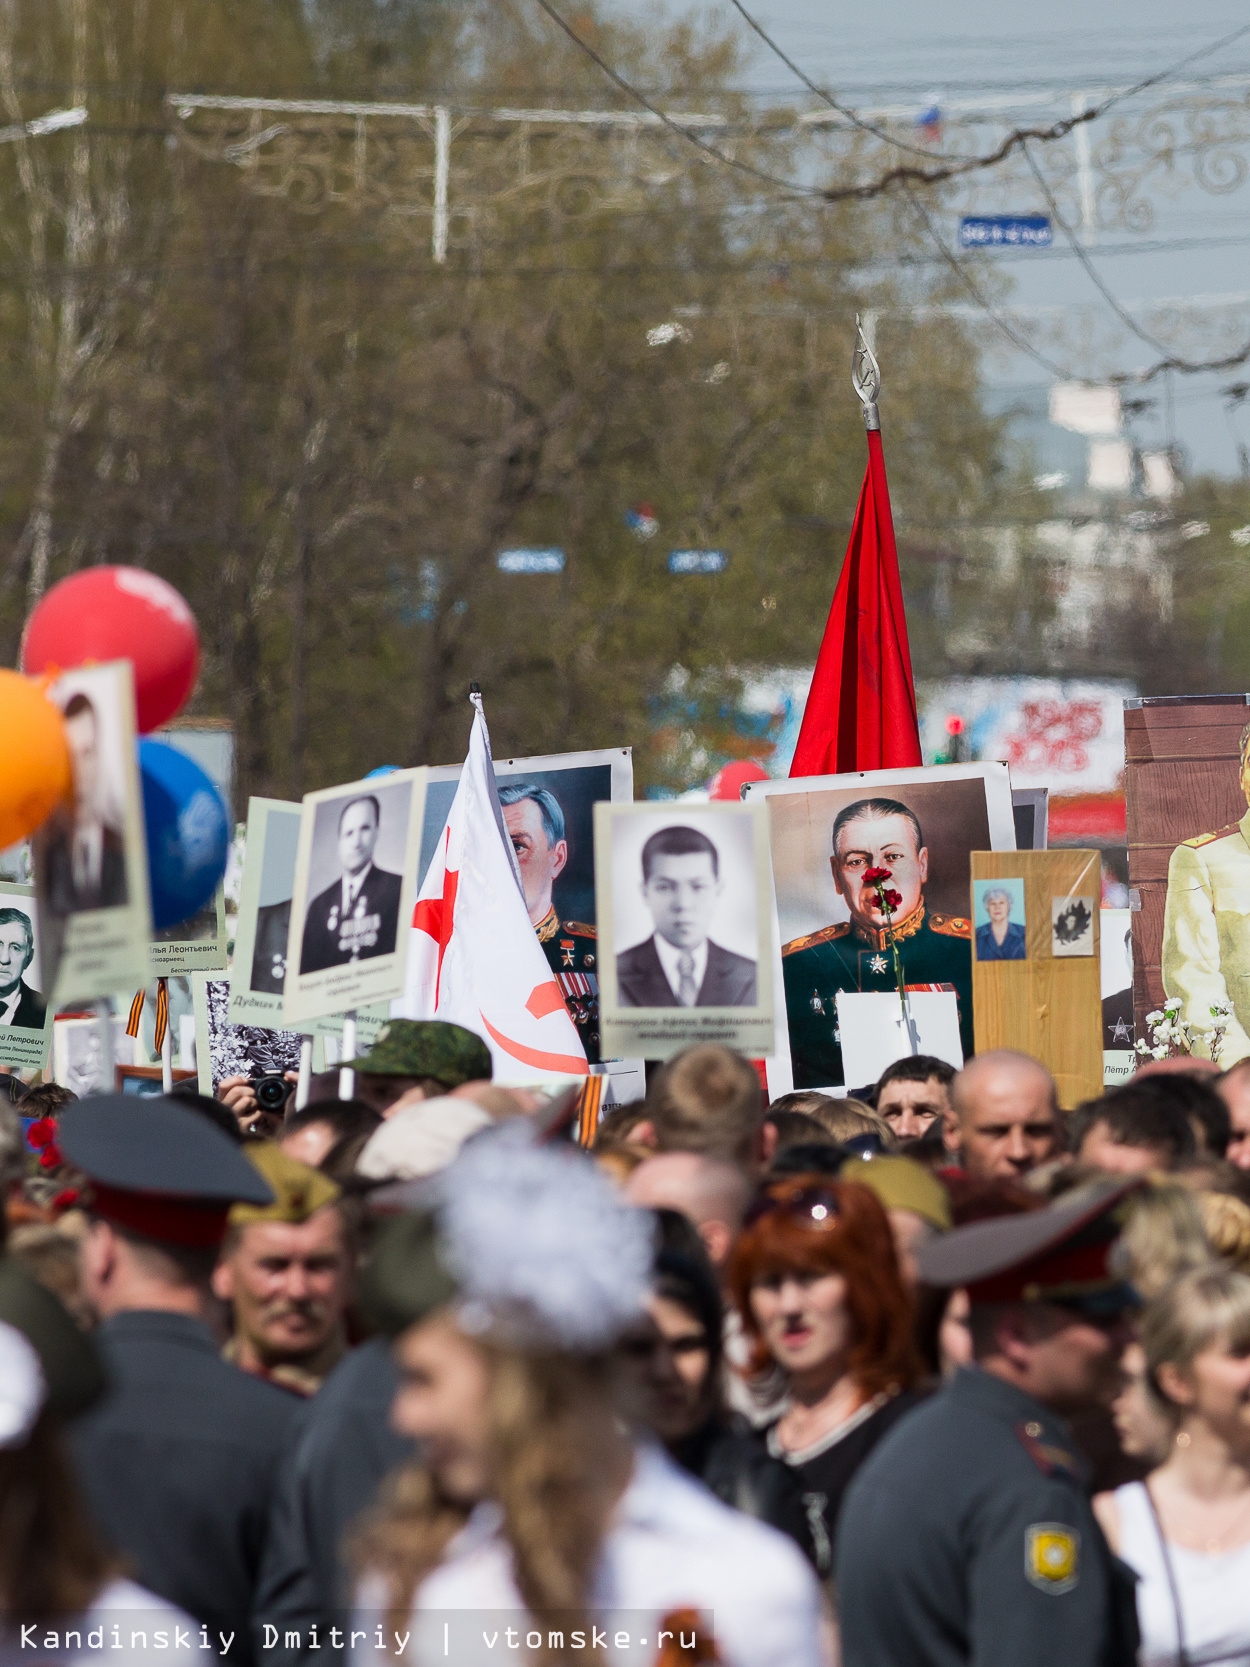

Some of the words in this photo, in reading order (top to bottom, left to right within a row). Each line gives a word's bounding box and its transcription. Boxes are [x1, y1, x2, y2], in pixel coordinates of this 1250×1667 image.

[168, 945, 218, 954] Леонтьевич
[7, 1034, 45, 1046] Петрович
[1104, 1065, 1129, 1076] Пётр
